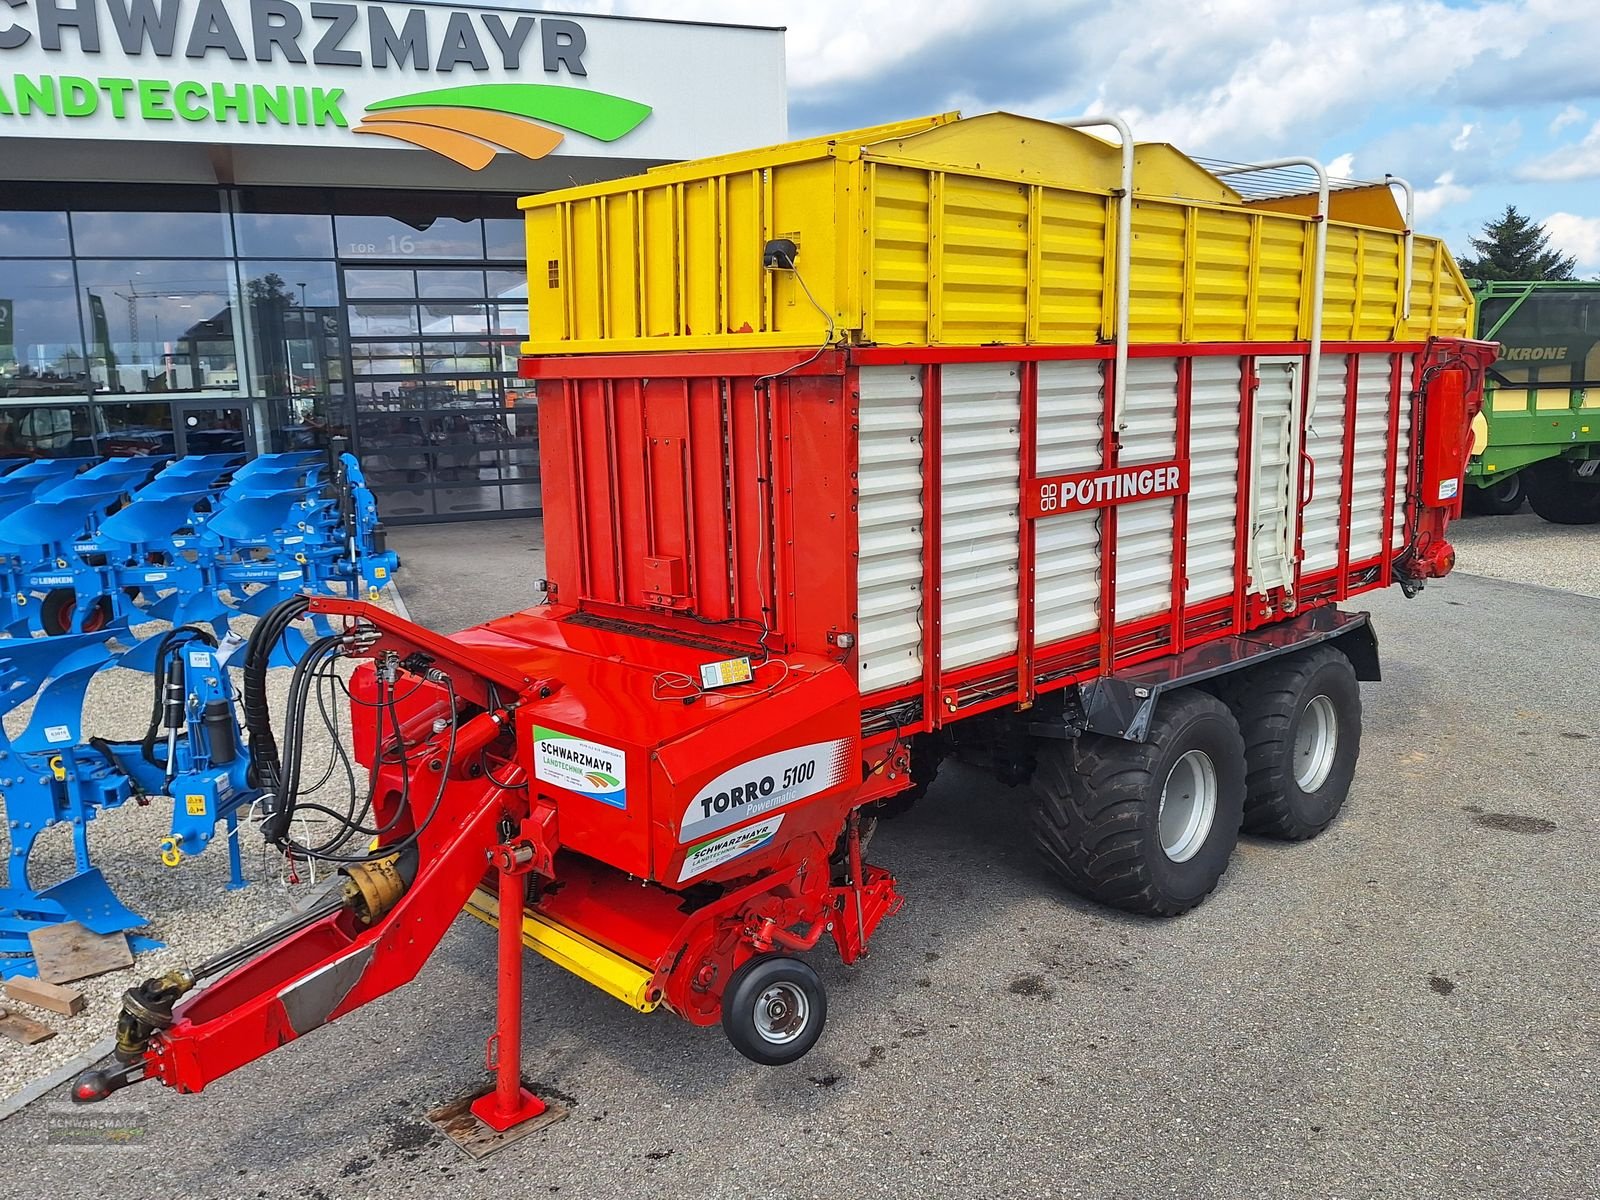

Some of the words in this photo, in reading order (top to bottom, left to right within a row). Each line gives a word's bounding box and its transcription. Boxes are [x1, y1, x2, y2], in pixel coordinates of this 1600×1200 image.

[350, 243, 376, 253] TOR
[387, 234, 415, 253] 16
[1507, 347, 1568, 361] KRONE
[38, 576, 74, 585] LEMKEN
[541, 741, 612, 774] SCHWARZMAYR
[543, 756, 584, 776] LANDTECHNIK
[701, 776, 775, 818] TORRO
[782, 760, 816, 789] 5100
[746, 790, 797, 816] Powermatic
[693, 826, 769, 860] SCHWARZMAYR
